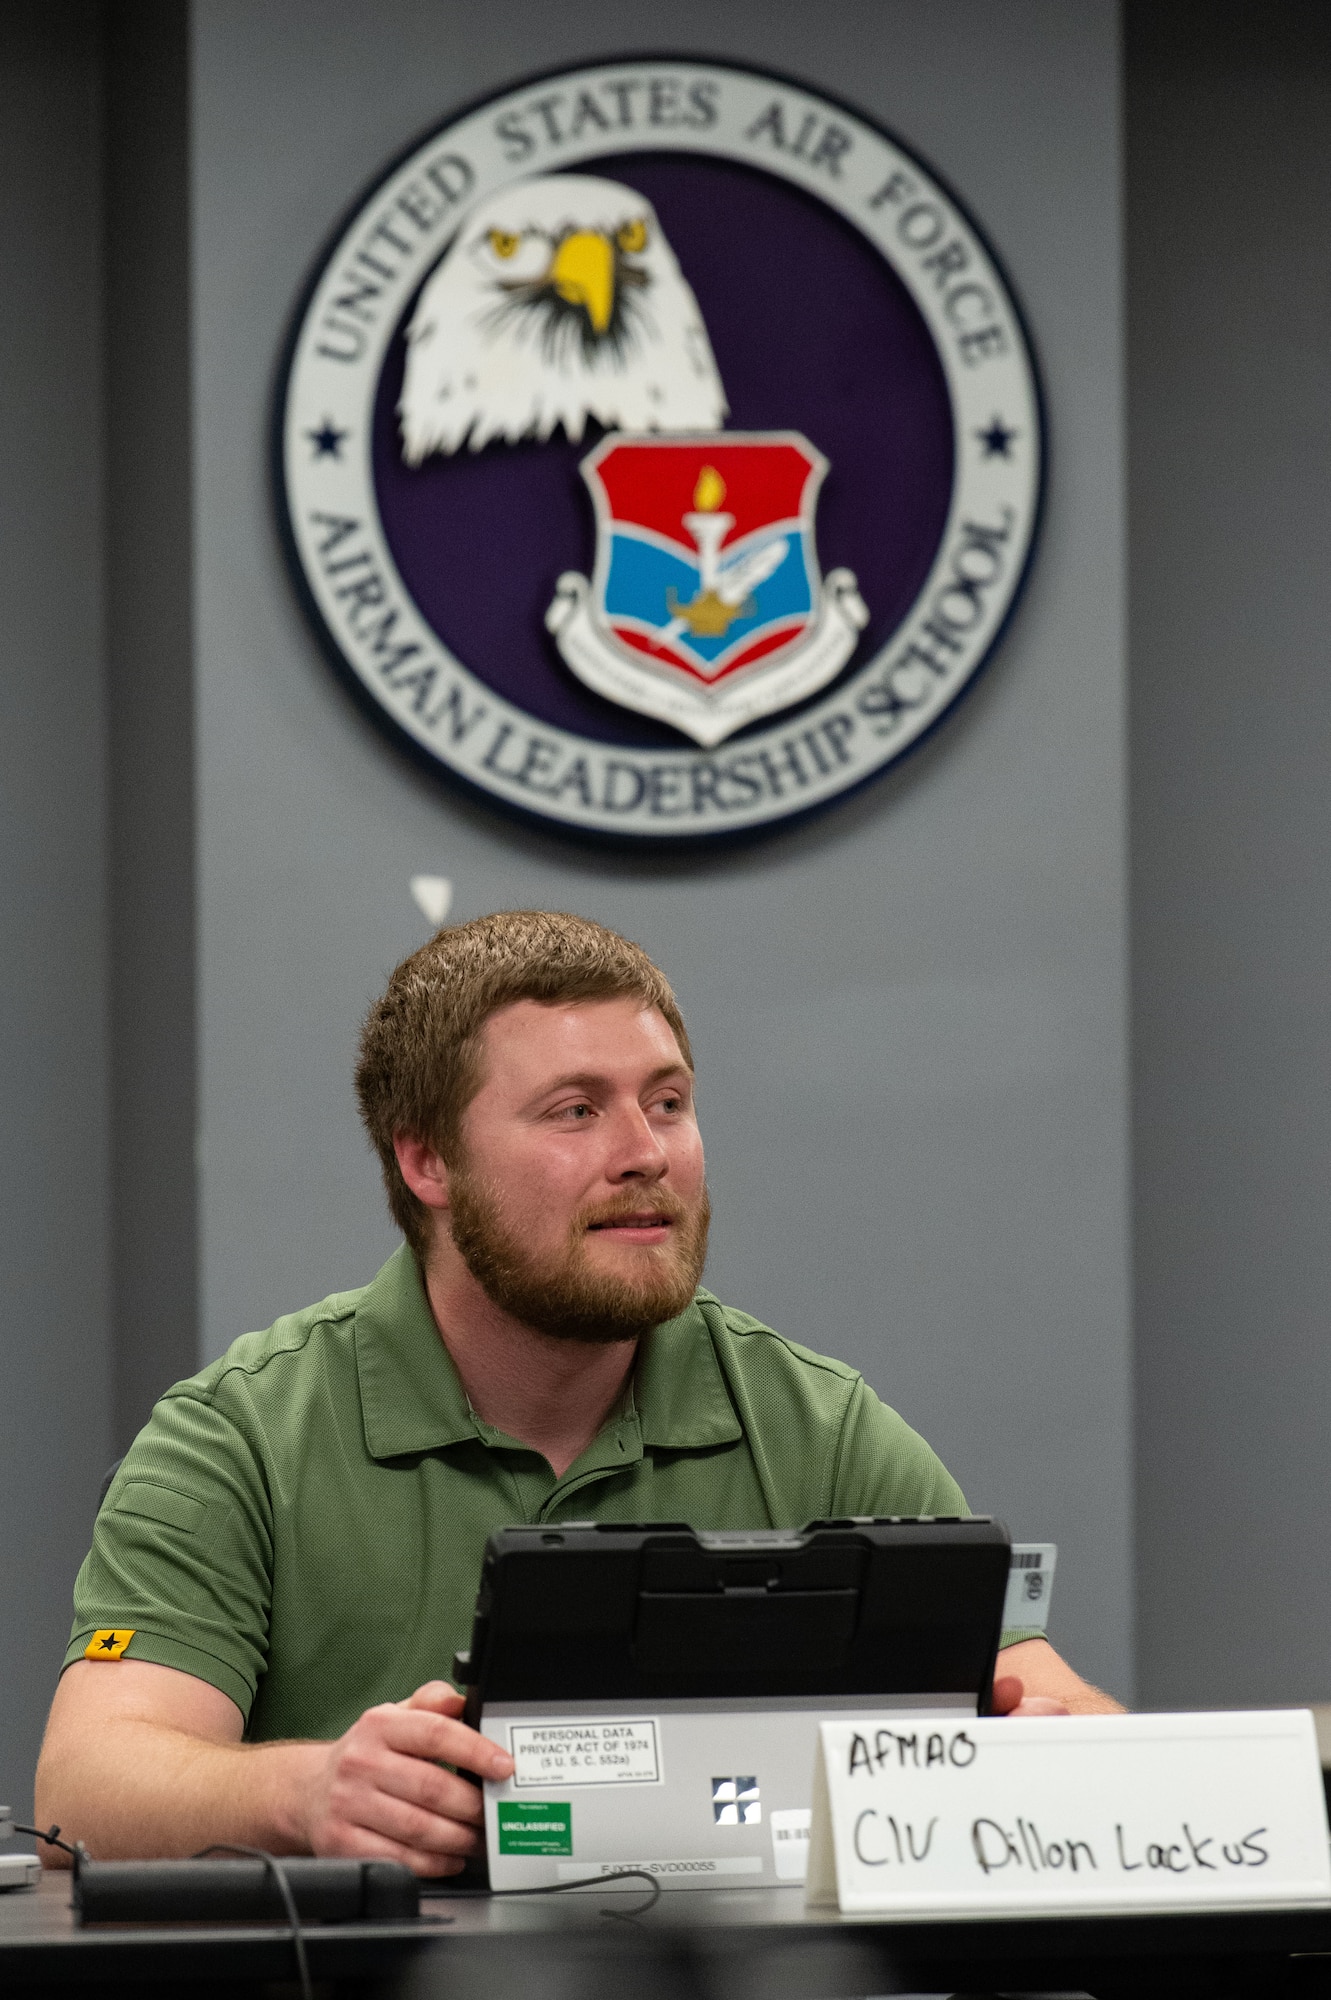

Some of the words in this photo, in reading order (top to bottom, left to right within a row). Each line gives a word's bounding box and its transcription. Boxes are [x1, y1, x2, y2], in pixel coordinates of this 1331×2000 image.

[315, 151, 478, 364] UNITED
[494, 78, 720, 162] STATES
[745, 100, 854, 180] AIR
[868, 169, 1009, 368] FORCE
[310, 508, 486, 745] AIRMAN
[476, 713, 858, 816] LEADERSHIP
[857, 508, 1016, 738] SCHOOL
[519, 1743, 571, 1755] PRIVACY
[575, 1742, 599, 1753] ACT
[603, 1741, 619, 1752] OF
[624, 1739, 649, 1751] 1974
[532, 1729, 599, 1741] PERSONAL
[602, 1727, 633, 1738] DATA
[848, 1731, 977, 1777] AFMAO
[501, 1821, 566, 1832] UNCLASSIFIED
[854, 1810, 939, 1867] CIV
[972, 1818, 1099, 1875] Dillon
[1116, 1823, 1270, 1873] Lackus
